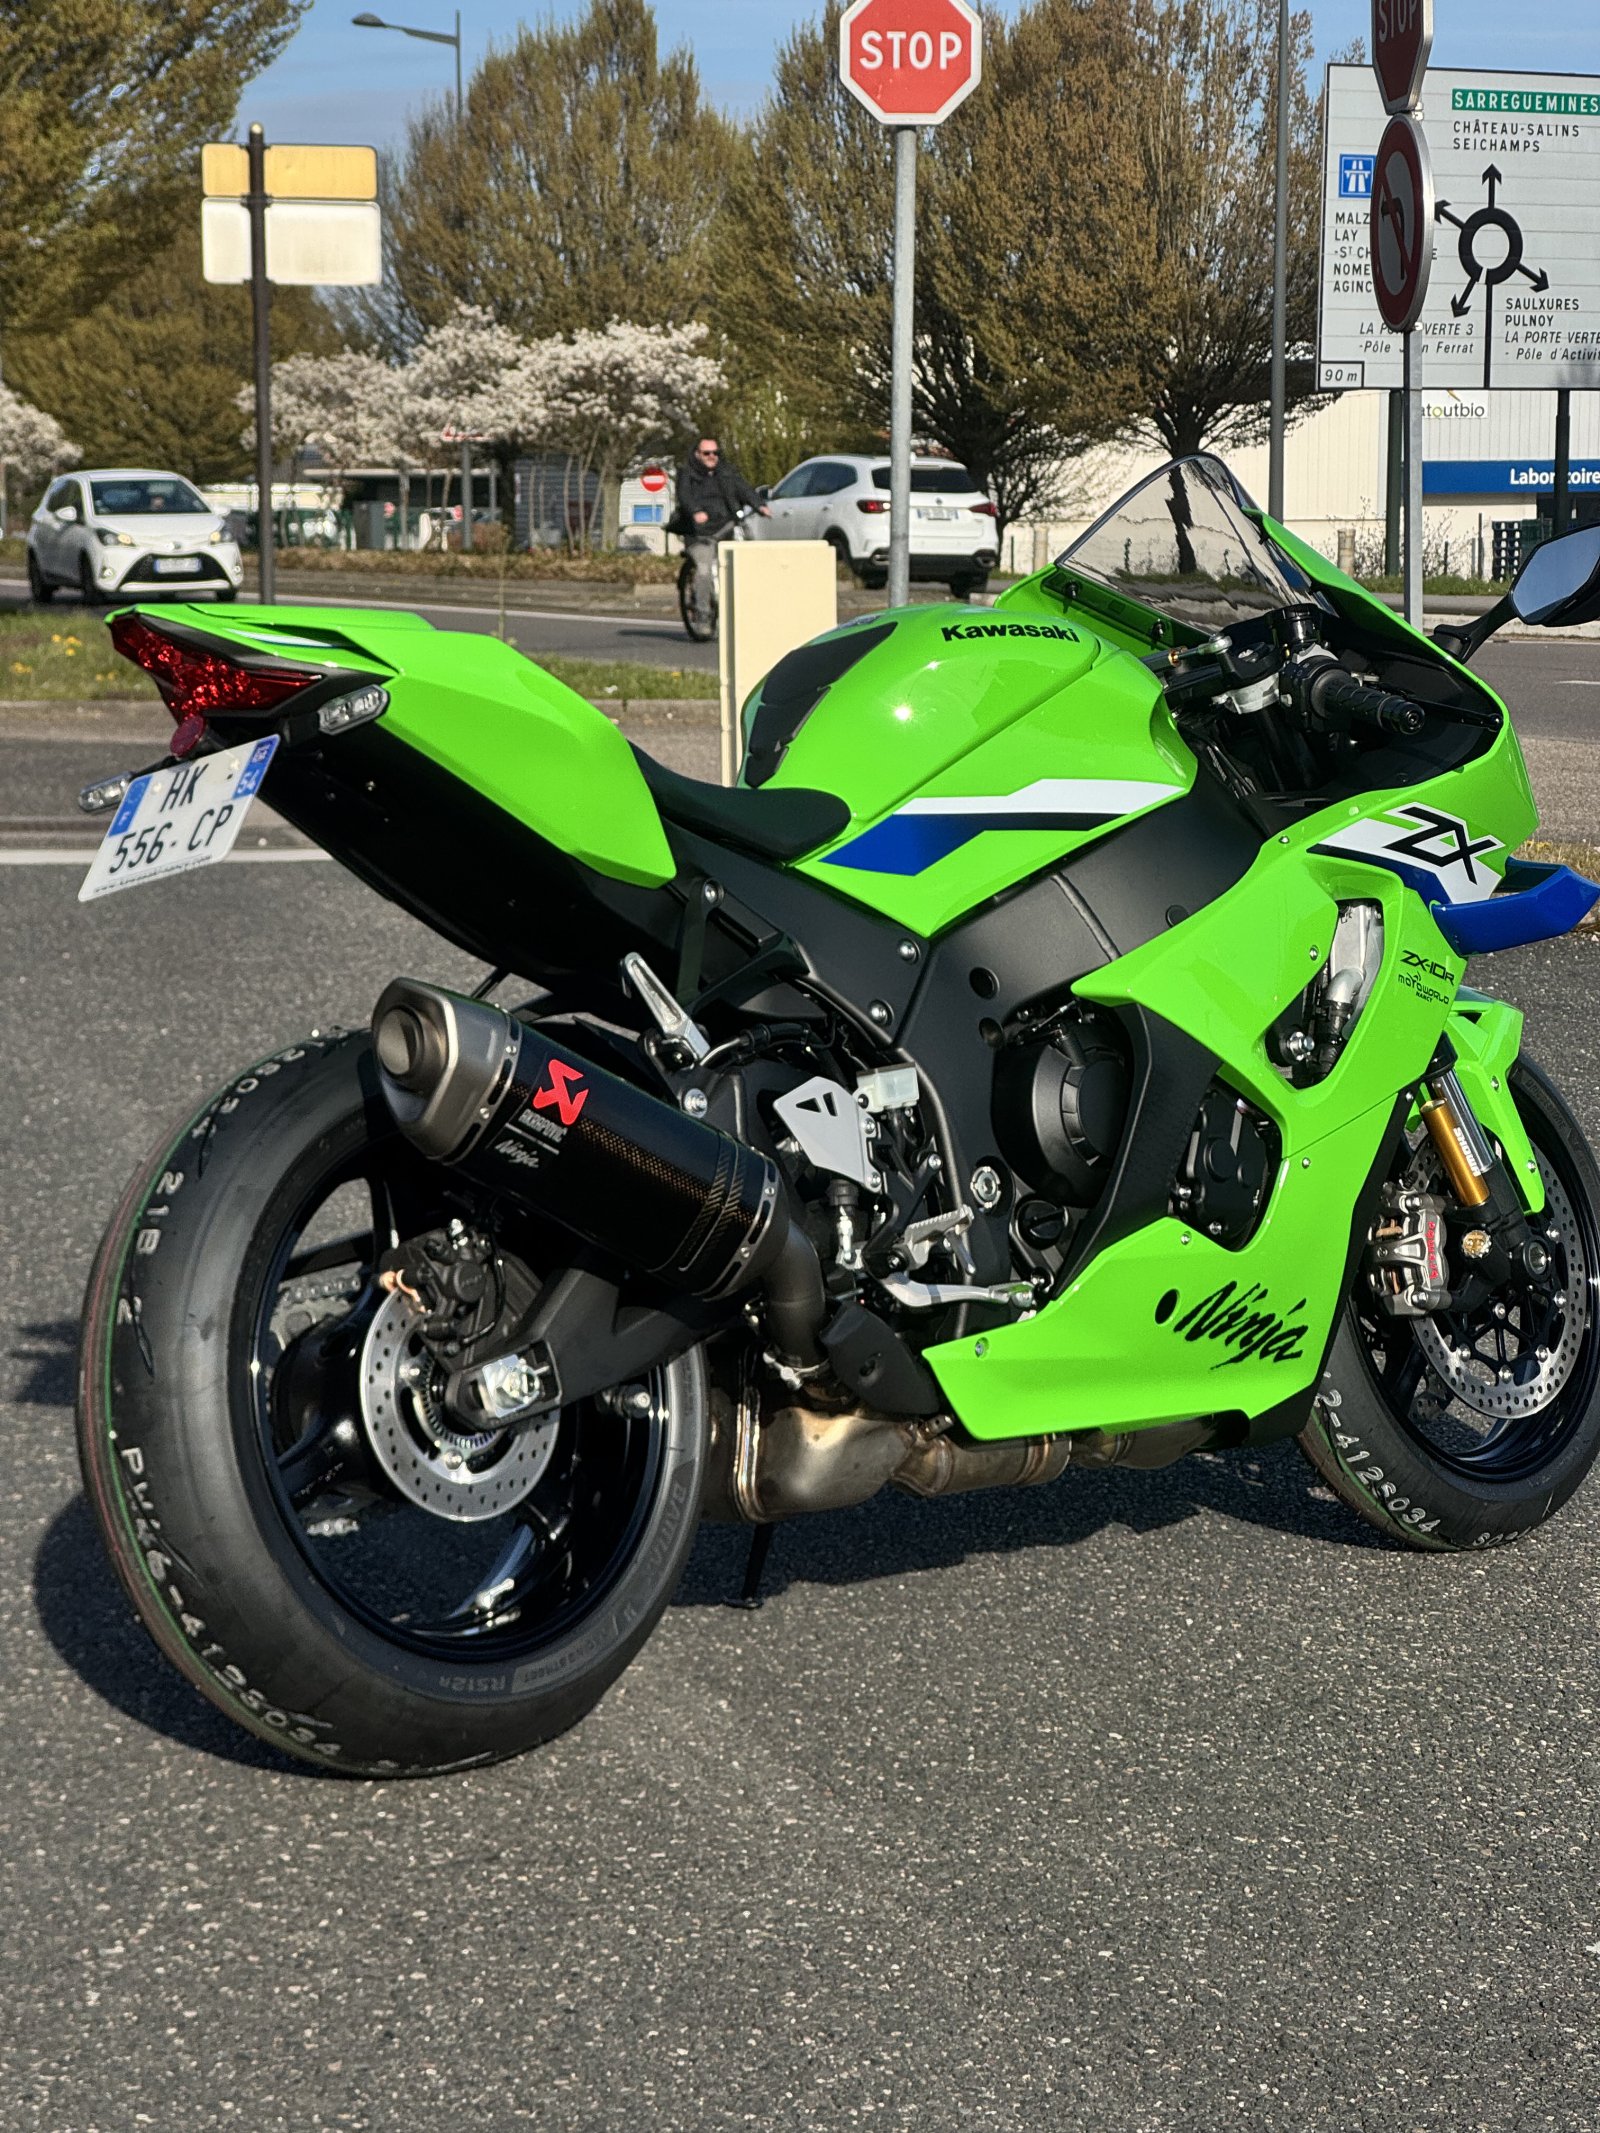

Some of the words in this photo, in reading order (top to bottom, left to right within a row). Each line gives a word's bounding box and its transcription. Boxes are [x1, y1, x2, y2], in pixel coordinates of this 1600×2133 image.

[859, 30, 963, 70] STOP
[1454, 90, 1599, 113] SARREGUEMINES
[1453, 118, 1580, 138] CHÂTEAU-SALINS
[1453, 137, 1541, 153] SEICHAMPS
[1335, 211, 1371, 225] MALZ
[1334, 229, 1358, 242] LAY
[1333, 263, 1371, 276] NOME
[1333, 280, 1373, 293] AGINC
[1505, 297, 1580, 311] SAULXURES
[1359, 321, 1374, 335] LA
[1424, 322, 1462, 336] VERTE
[1465, 323, 1474, 336] 3
[1505, 314, 1554, 327] PULNOY
[1504, 330, 1519, 344] LA
[1524, 330, 1562, 344] PORTE
[1435, 341, 1475, 354] Ferrat
[1516, 347, 1543, 361] Pôle
[1324, 369, 1344, 382] 90
[1346, 372, 1358, 382] m
[1510, 467, 1600, 485] Laboroire
[941, 623, 1081, 643] Kawasaki
[160, 763, 209, 813] HK
[1382, 805, 1498, 886] ZX
[1400, 949, 1455, 986] ZX-10R
[494, 1139, 540, 1169] Ninja
[1453, 1126, 1482, 1177] SHOWA
[1172, 1280, 1309, 1371] Ninja
